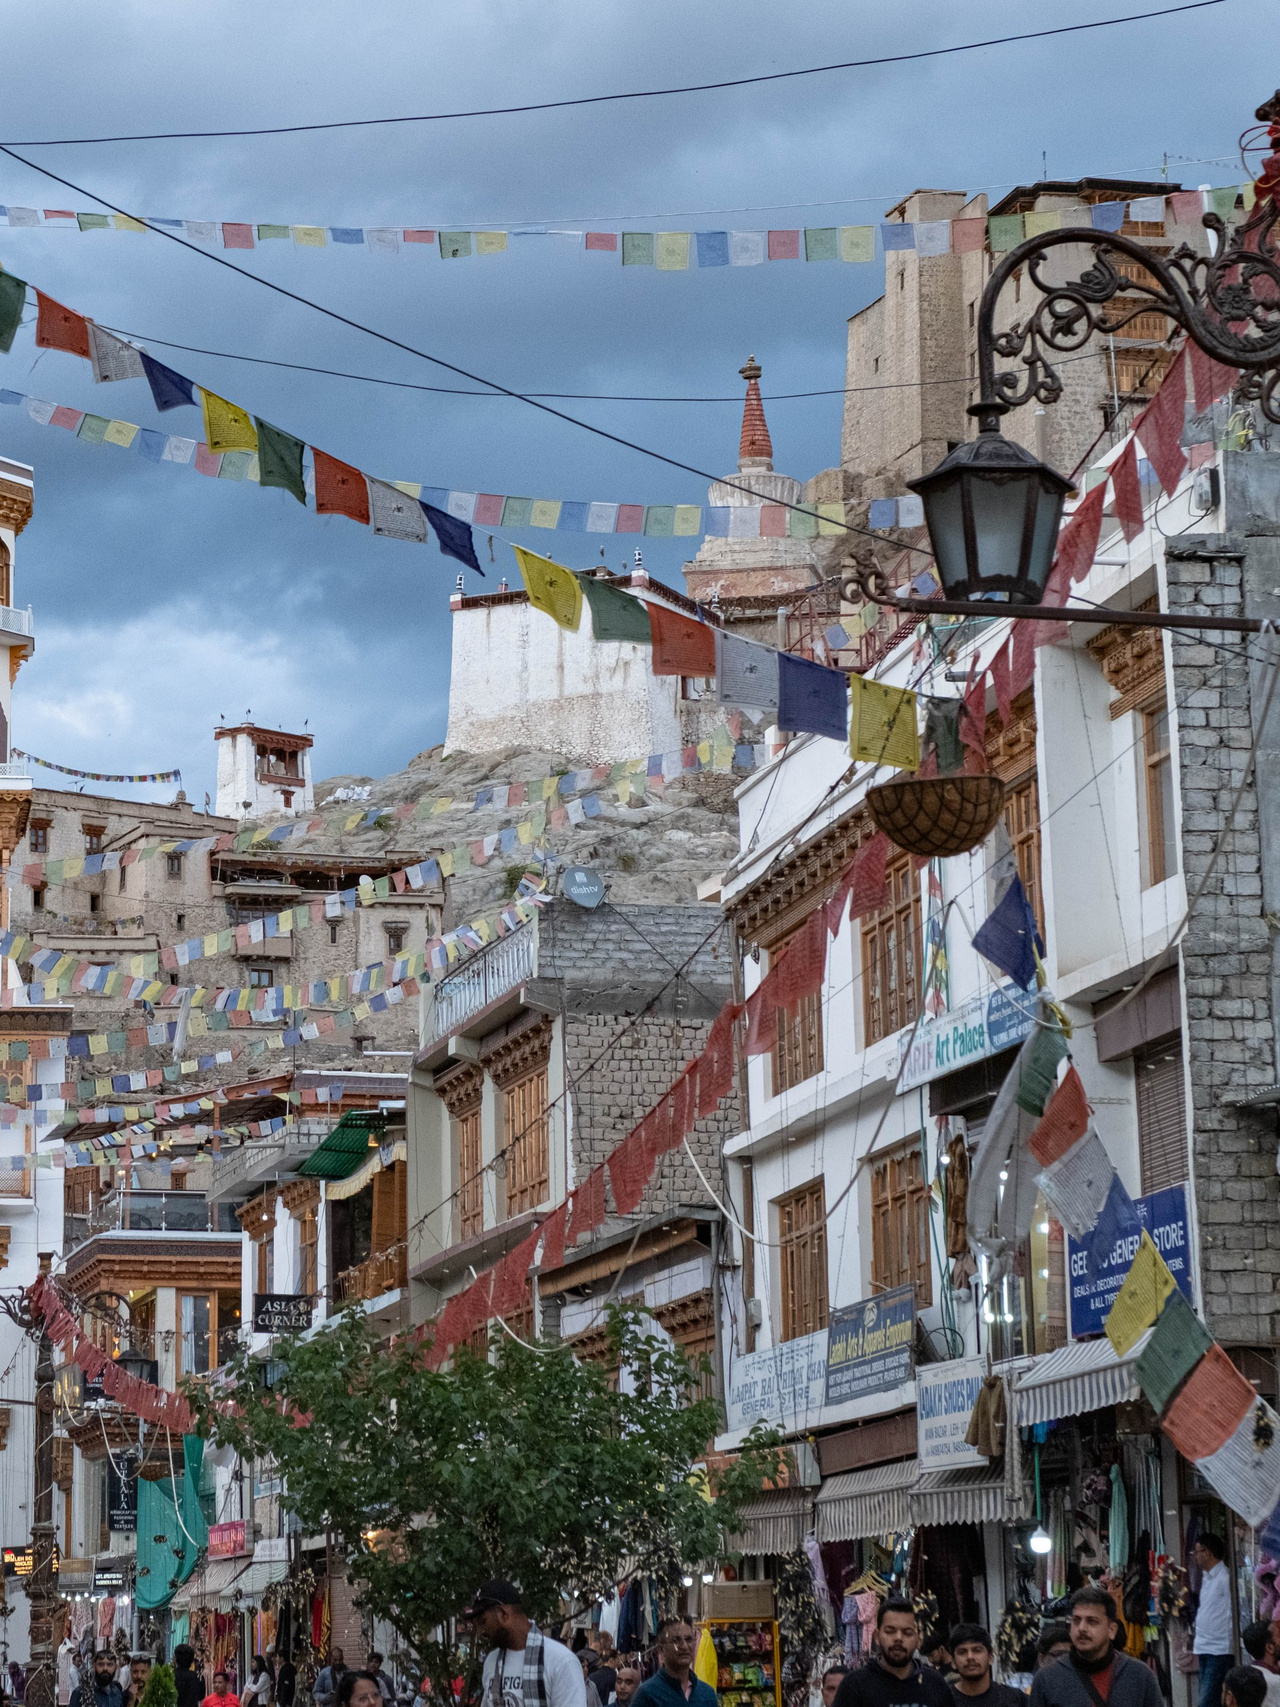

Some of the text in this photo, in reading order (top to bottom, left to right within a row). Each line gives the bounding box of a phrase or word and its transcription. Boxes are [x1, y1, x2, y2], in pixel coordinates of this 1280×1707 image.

[571, 885, 598, 894] dishtv
[935, 1032, 950, 1068] Art
[952, 1022, 985, 1060] Palace
[1153, 1221, 1186, 1252] STORE
[1073, 1282, 1089, 1299] DEALS
[1095, 1295, 1105, 1308] ALL
[258, 1314, 309, 1327] CORNER
[761, 1376, 775, 1397] RAI
[944, 1378, 966, 1415] SHOES
[741, 1396, 775, 1416] GENERAL
[781, 1385, 810, 1405] STORE
